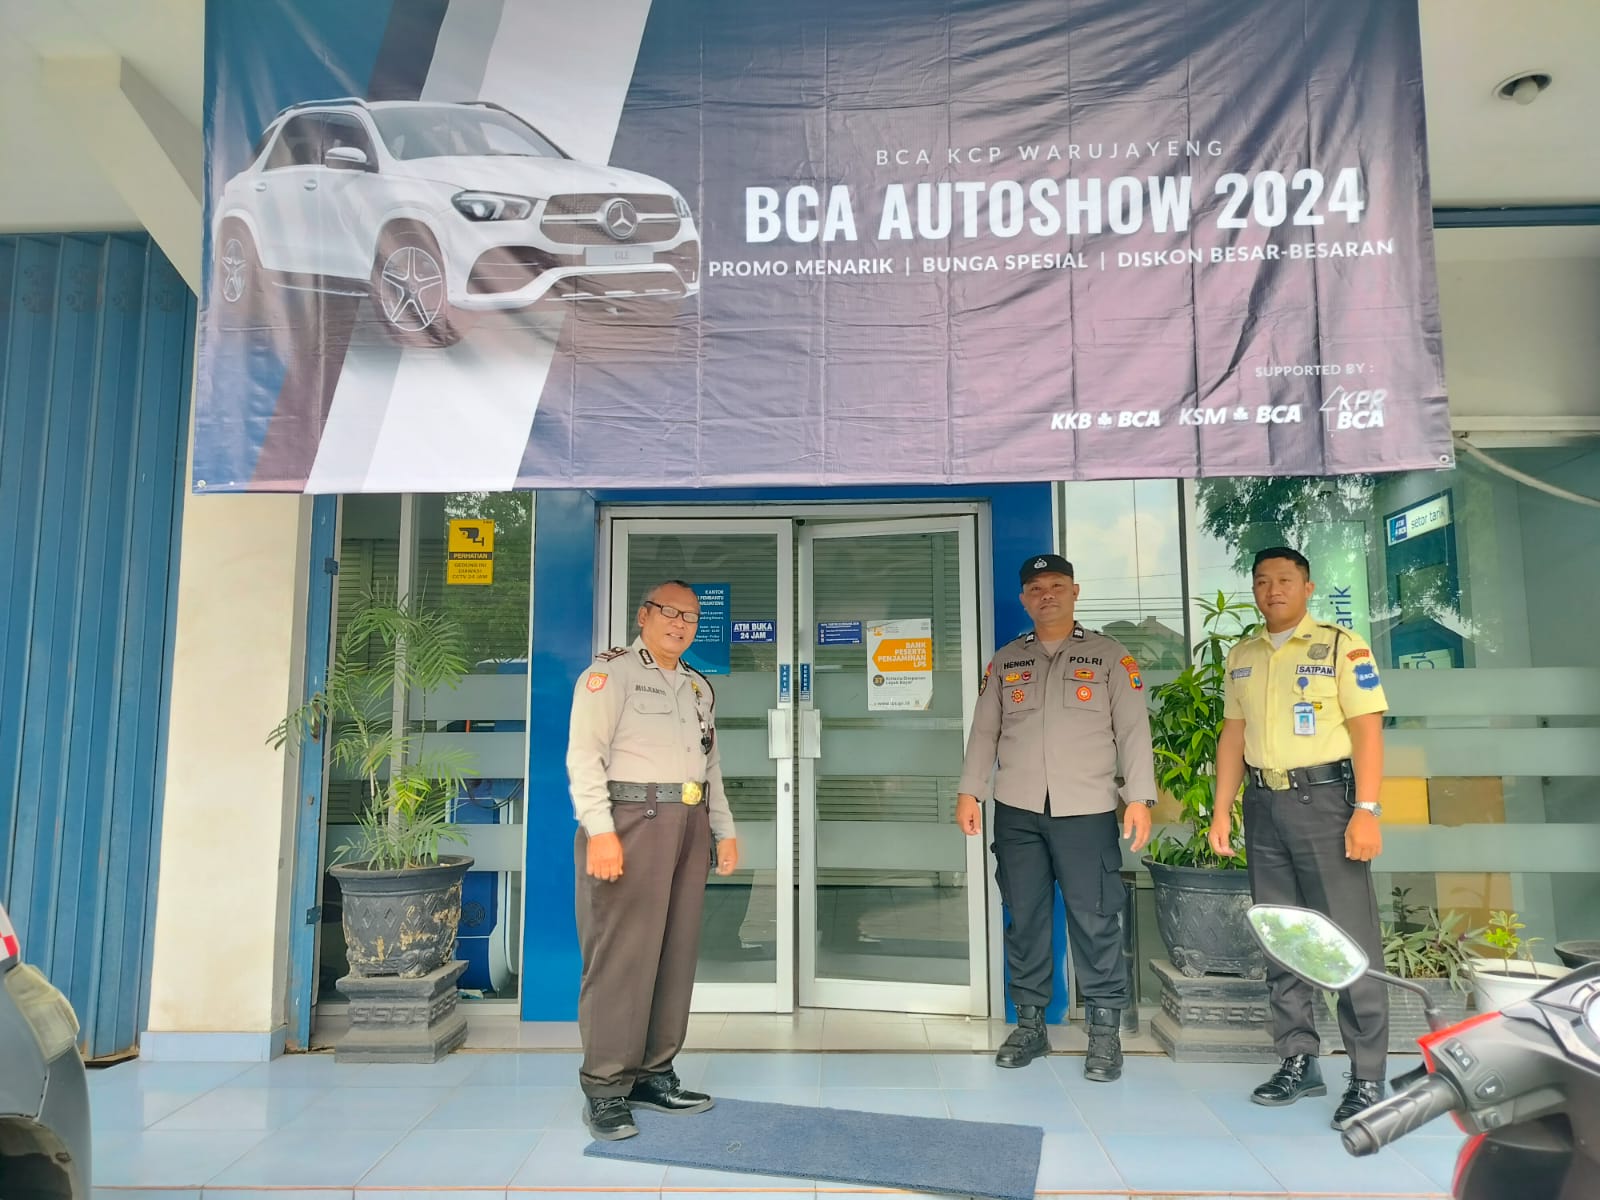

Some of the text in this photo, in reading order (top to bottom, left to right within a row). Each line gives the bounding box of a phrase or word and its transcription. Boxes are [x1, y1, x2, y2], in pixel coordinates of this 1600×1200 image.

[876, 139, 1224, 166] BCA KCP WARUJAYENG
[745, 167, 1366, 243] BCA AUTOSHOW 2024
[708, 239, 1394, 278] PROMO MENARIK BUNGA SPESIAL DISKON BESAR-BESARAN
[1255, 363, 1366, 378] SUPPORTED BY
[1338, 388, 1388, 411] KPR
[1051, 411, 1161, 430] KKB BCA
[1178, 404, 1301, 426] KSM BCA
[1336, 411, 1385, 430] BCA
[1329, 586, 1352, 630] arik
[733, 623, 772, 631] ATM BUKA
[740, 632, 750, 640] 24
[894, 648, 927, 656] PESERTA
[905, 641, 926, 649] BANK
[877, 655, 927, 663] PENJAMINAN
[1003, 656, 1103, 670] HENGKY POLRI
[1298, 666, 1333, 675] SATPAM
